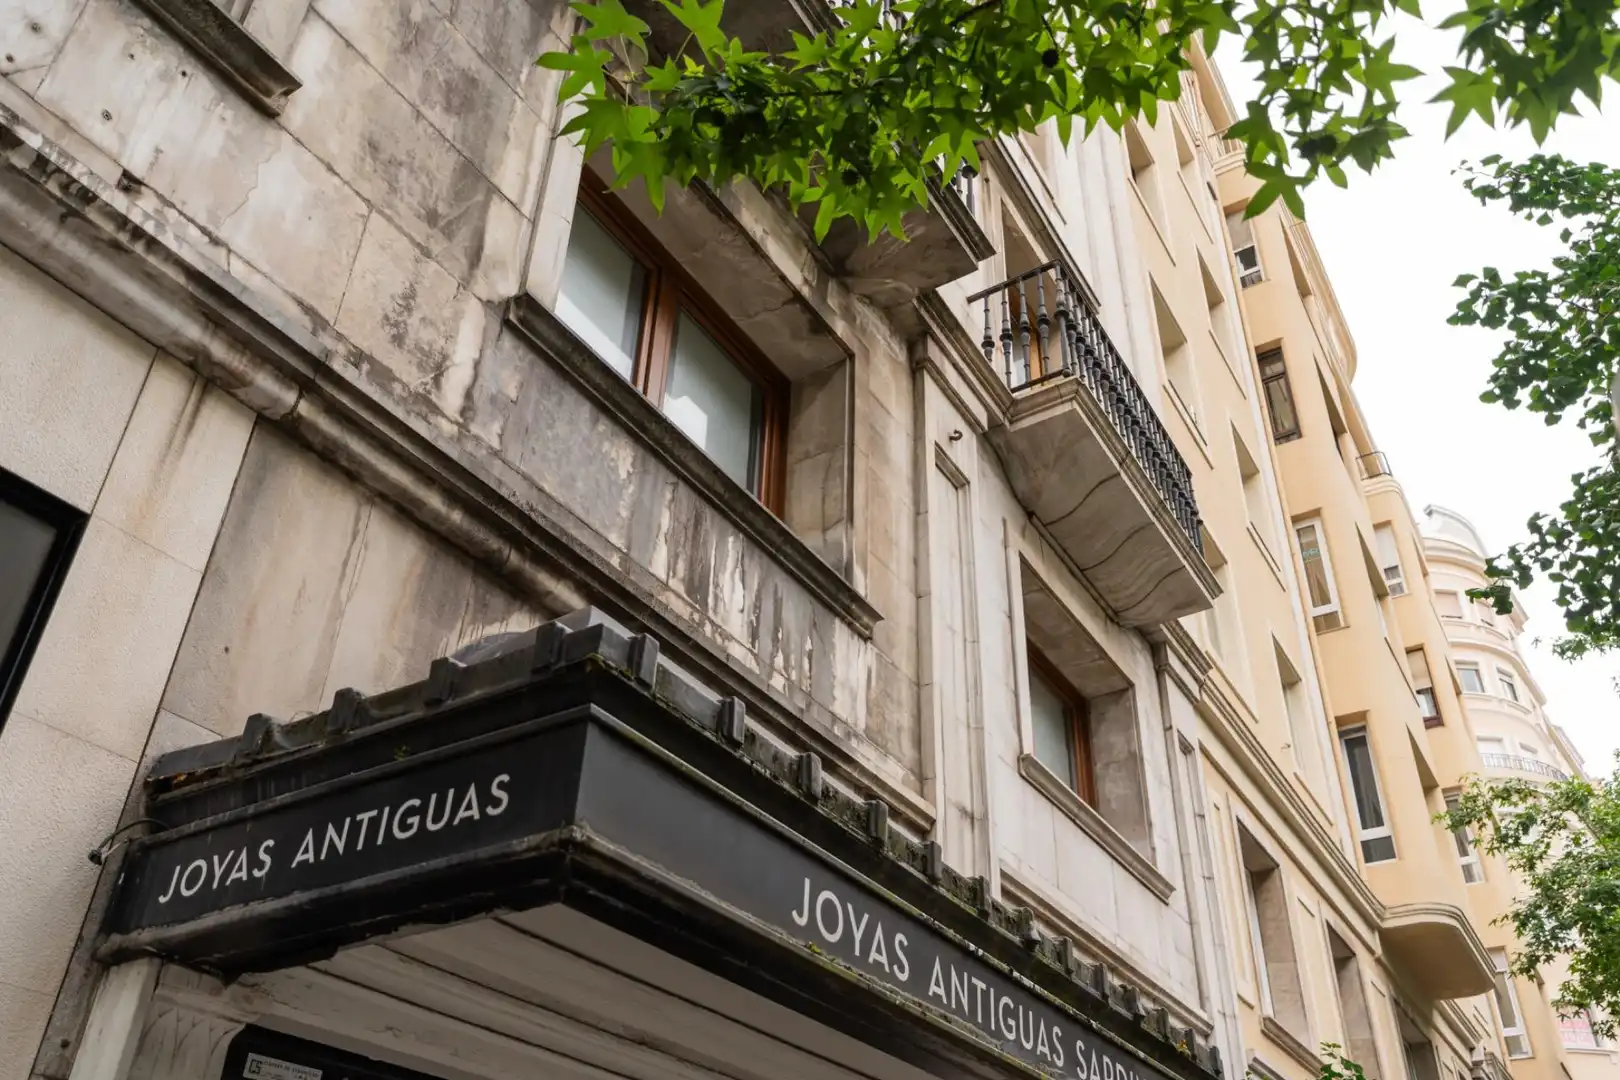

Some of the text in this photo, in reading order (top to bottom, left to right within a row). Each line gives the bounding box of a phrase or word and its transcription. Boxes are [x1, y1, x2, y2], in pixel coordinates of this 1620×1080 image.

[158, 774, 510, 904] JOYAS ANTIGUAS
[791, 877, 1146, 1080] JOYAS ANTIGUAS SAR
